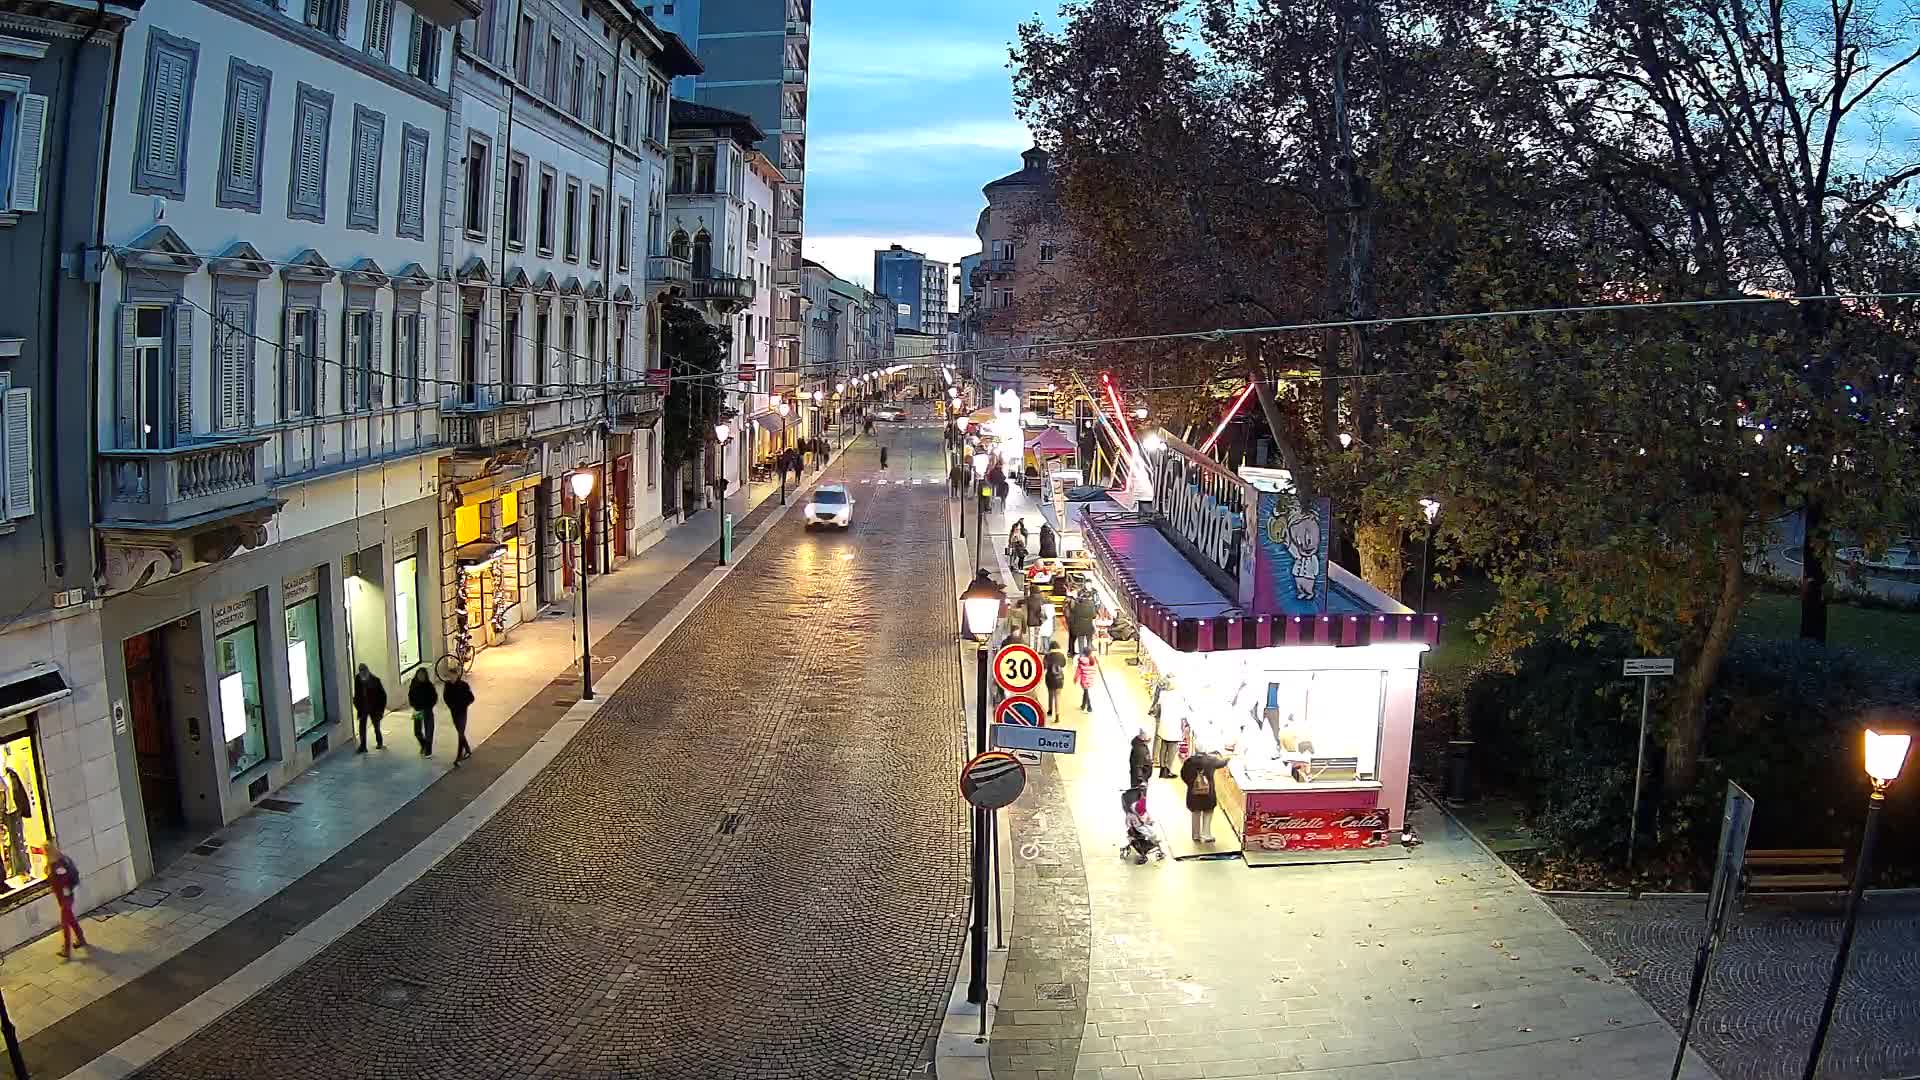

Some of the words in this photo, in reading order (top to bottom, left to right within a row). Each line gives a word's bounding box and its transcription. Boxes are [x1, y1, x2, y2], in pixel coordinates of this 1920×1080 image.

[1163, 457, 1232, 569] Golosone
[1005, 658, 1032, 679] 30
[1038, 737, 1069, 748] Dante
